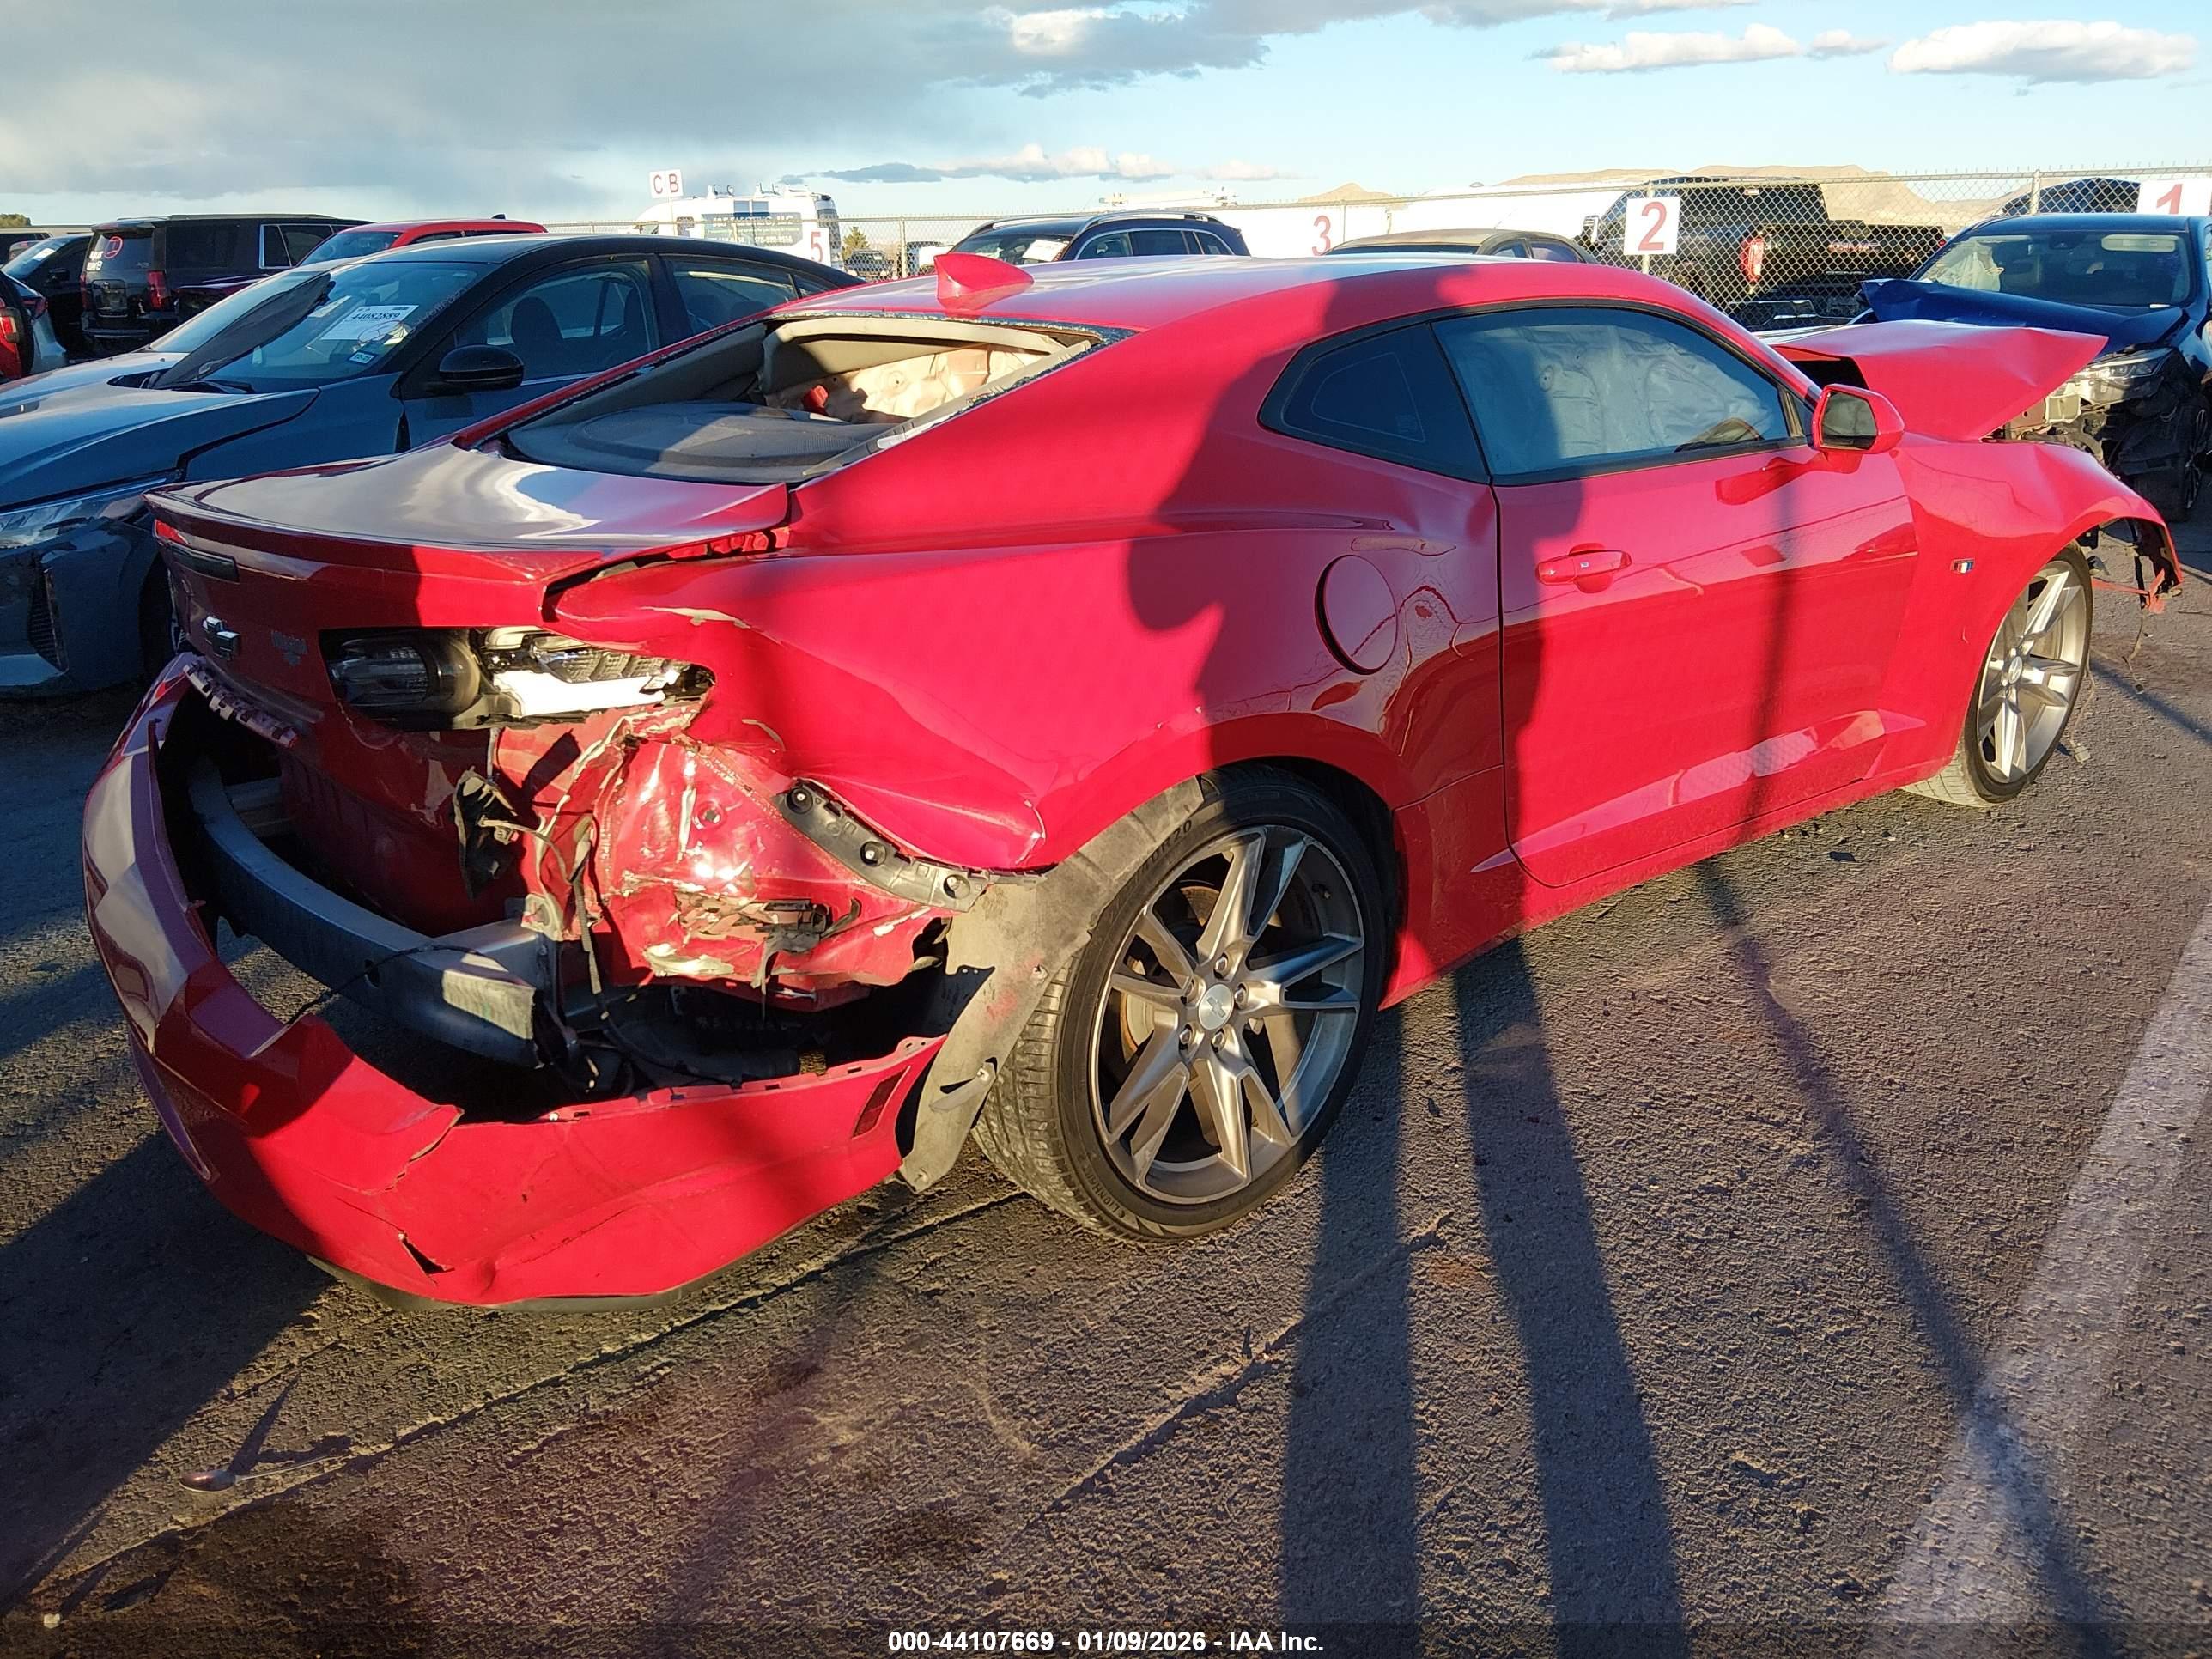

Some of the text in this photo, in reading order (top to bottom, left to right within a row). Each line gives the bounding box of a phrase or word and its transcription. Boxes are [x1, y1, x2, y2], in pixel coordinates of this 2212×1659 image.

[2156, 184, 2183, 214] 1
[1312, 215, 1331, 256] 3
[1638, 201, 1667, 251] 2
[811, 231, 823, 263] 5
